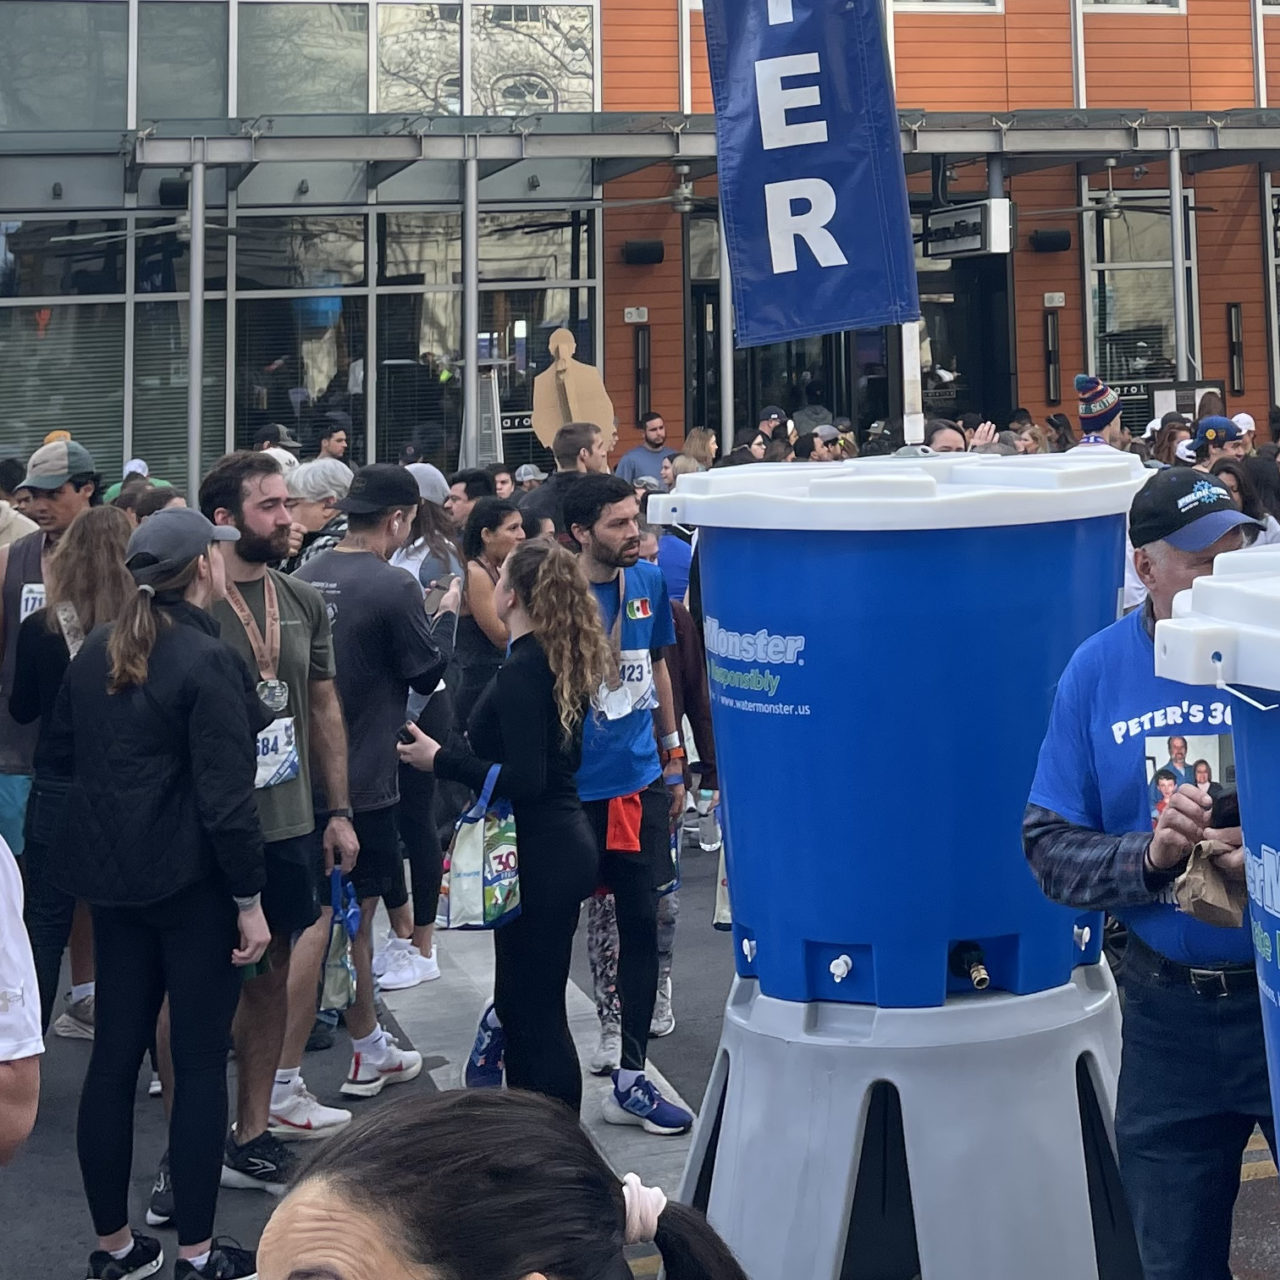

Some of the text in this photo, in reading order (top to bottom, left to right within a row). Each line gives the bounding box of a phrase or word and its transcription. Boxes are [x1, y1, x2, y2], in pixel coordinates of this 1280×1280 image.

[1114, 383, 1145, 395] arol
[502, 417, 531, 427] aro
[704, 614, 805, 664] Monster
[1111, 700, 1205, 745] PETER'S
[492, 850, 517, 874] 30
